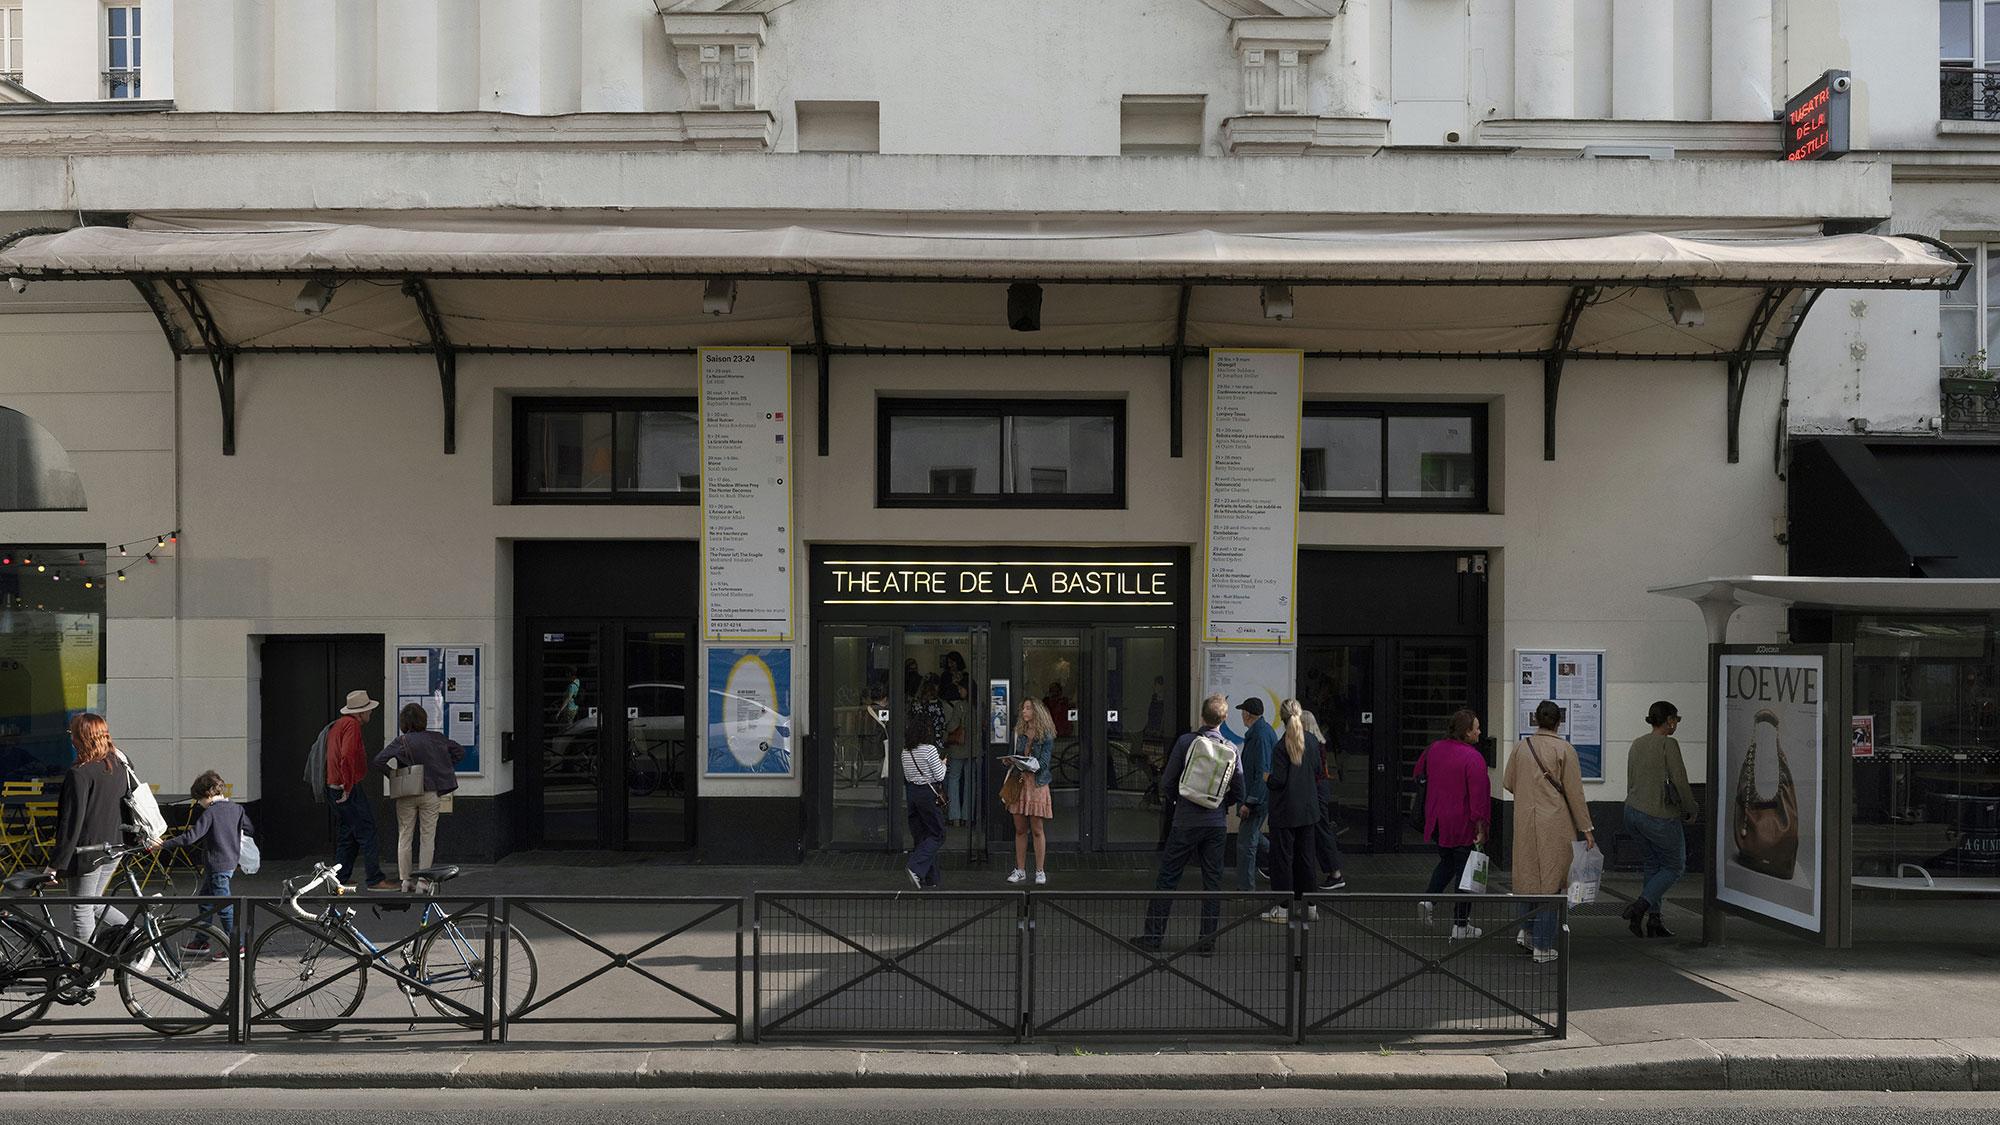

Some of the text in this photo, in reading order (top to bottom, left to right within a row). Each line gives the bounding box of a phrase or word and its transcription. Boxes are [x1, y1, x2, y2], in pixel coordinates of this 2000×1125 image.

[1796, 114, 1824, 140] DE LA
[832, 571, 1167, 595] THEATRE DE LA BASTILLE
[1726, 665, 1818, 704] LOEWE
